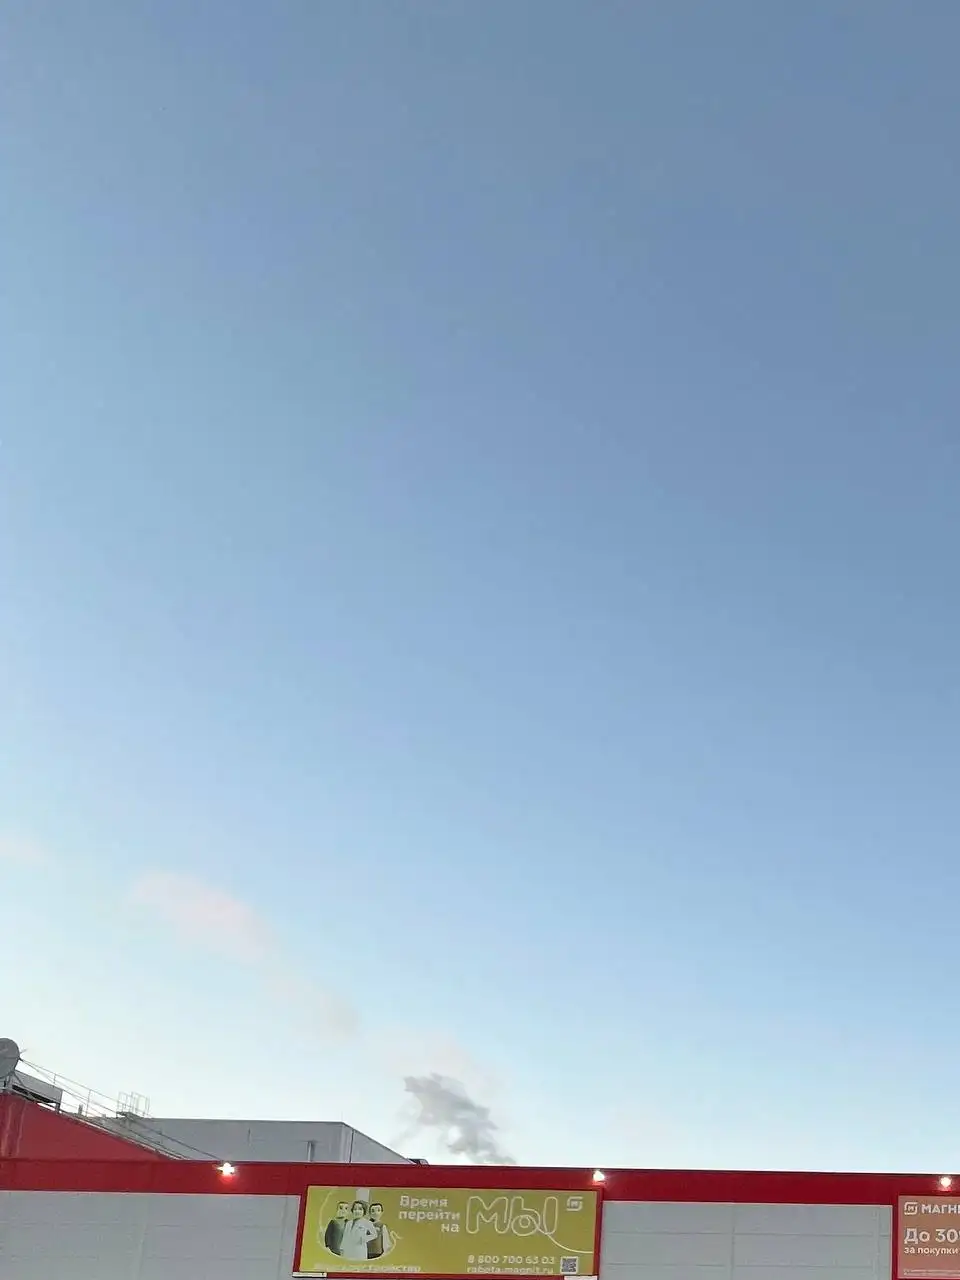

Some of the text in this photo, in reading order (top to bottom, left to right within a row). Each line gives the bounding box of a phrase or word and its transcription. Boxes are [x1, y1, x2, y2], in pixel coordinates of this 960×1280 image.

[399, 1195, 449, 1208] Время
[398, 1209, 461, 1222] перейти
[440, 1222, 461, 1233] на
[904, 1228, 931, 1244] До
[904, 1246, 915, 1254] за
[917, 1246, 959, 1256] покупки
[467, 1254, 475, 1264] 8
[477, 1255, 500, 1265] 800
[501, 1255, 523, 1265] 700
[525, 1256, 539, 1265] 63
